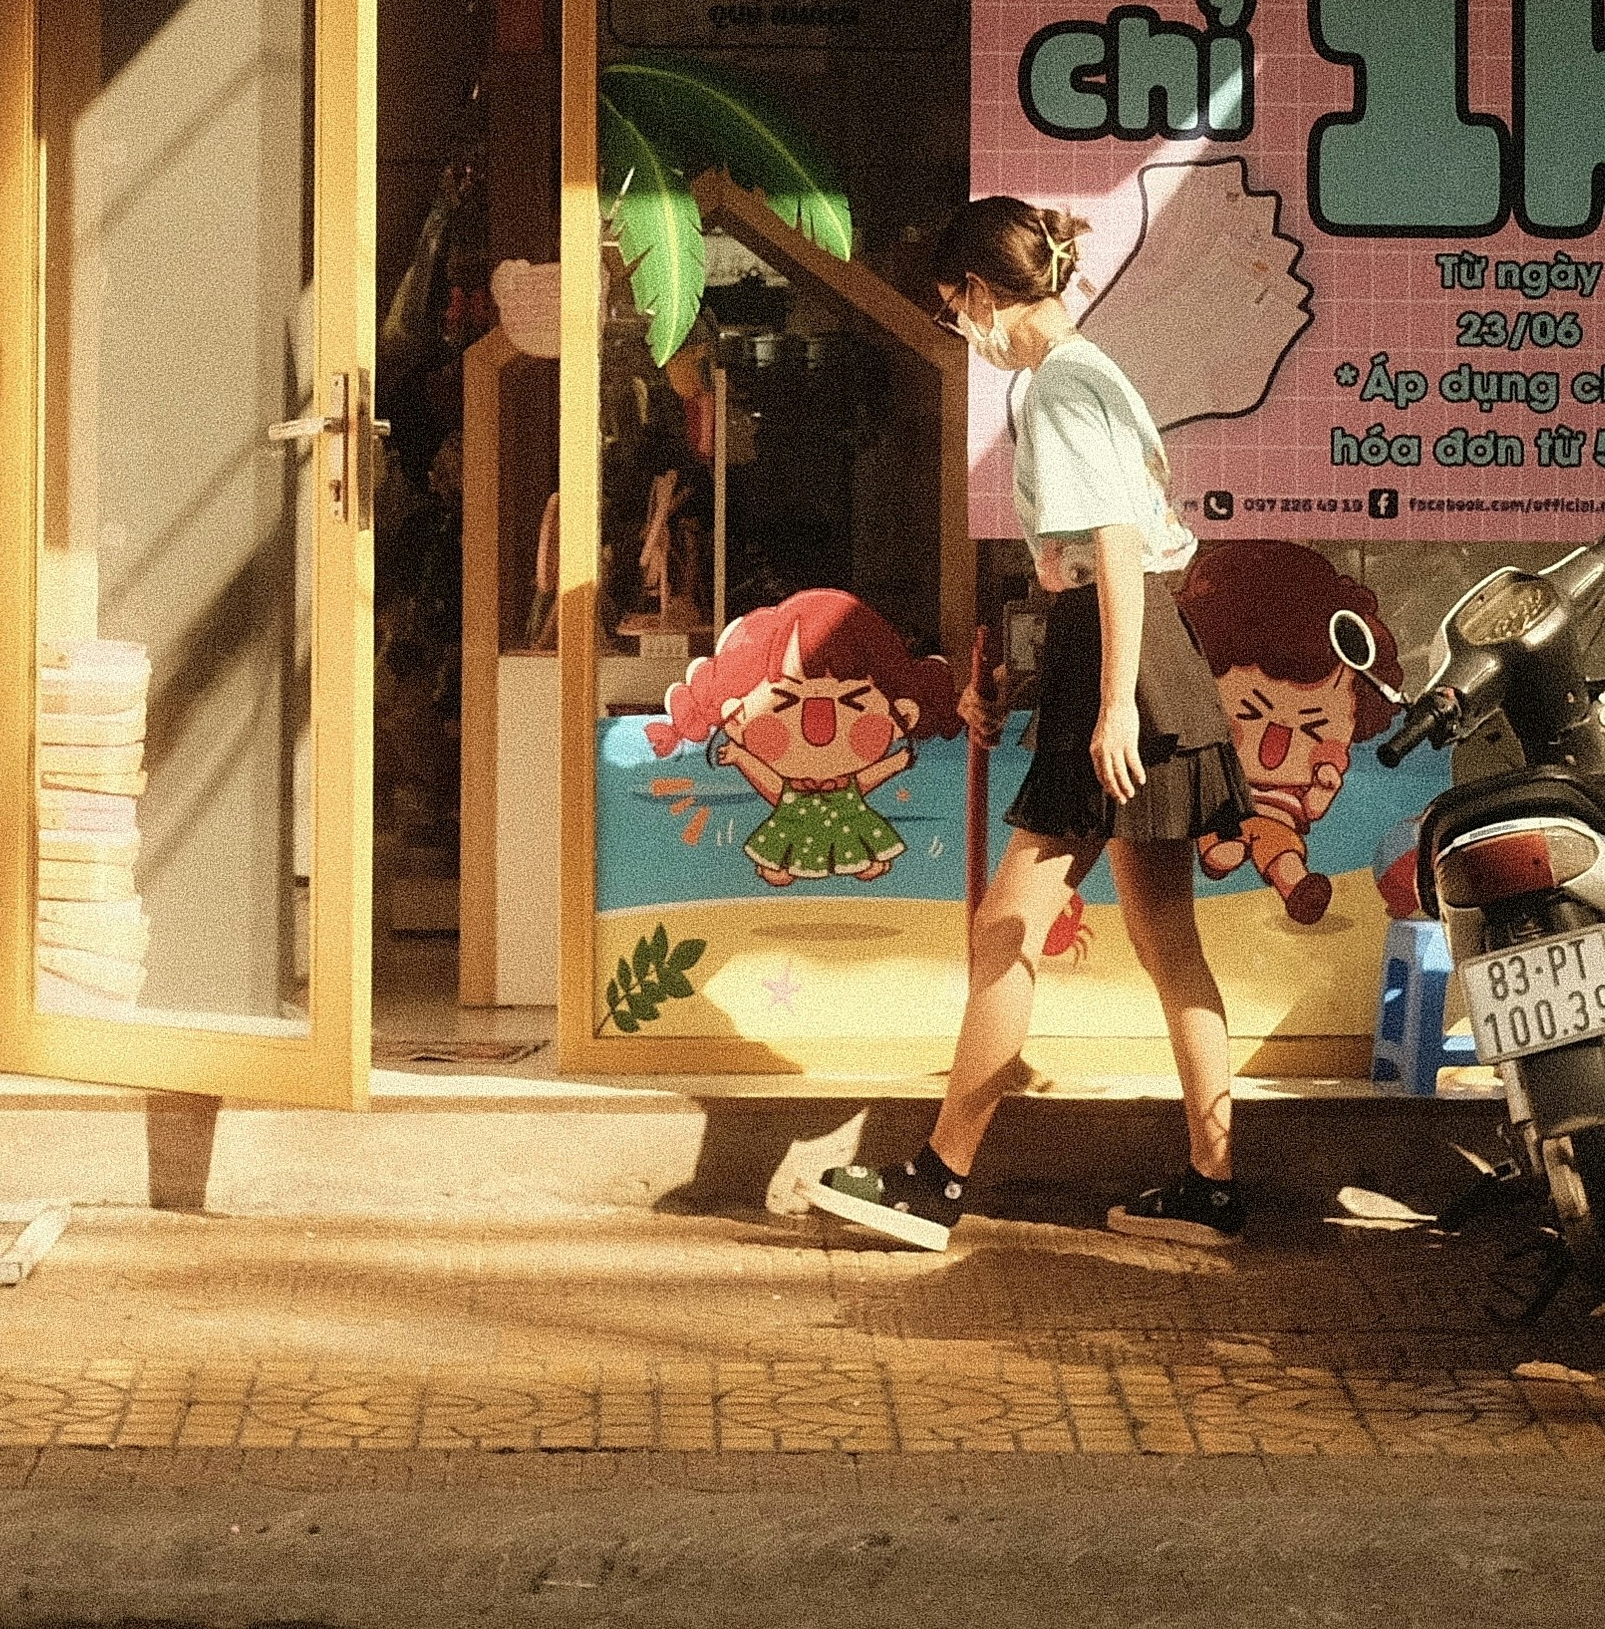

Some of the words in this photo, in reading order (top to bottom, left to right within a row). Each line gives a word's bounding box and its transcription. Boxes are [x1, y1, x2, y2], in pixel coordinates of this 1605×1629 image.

[1435, 250, 1489, 289] Từ
[1495, 250, 1604, 299] ngày
[1455, 310, 1584, 351] 23/06
[1439, 363, 1561, 413] dụng
[1330, 424, 1422, 466] hóa
[1433, 427, 1525, 467] đơn
[1535, 424, 1587, 468] từ
